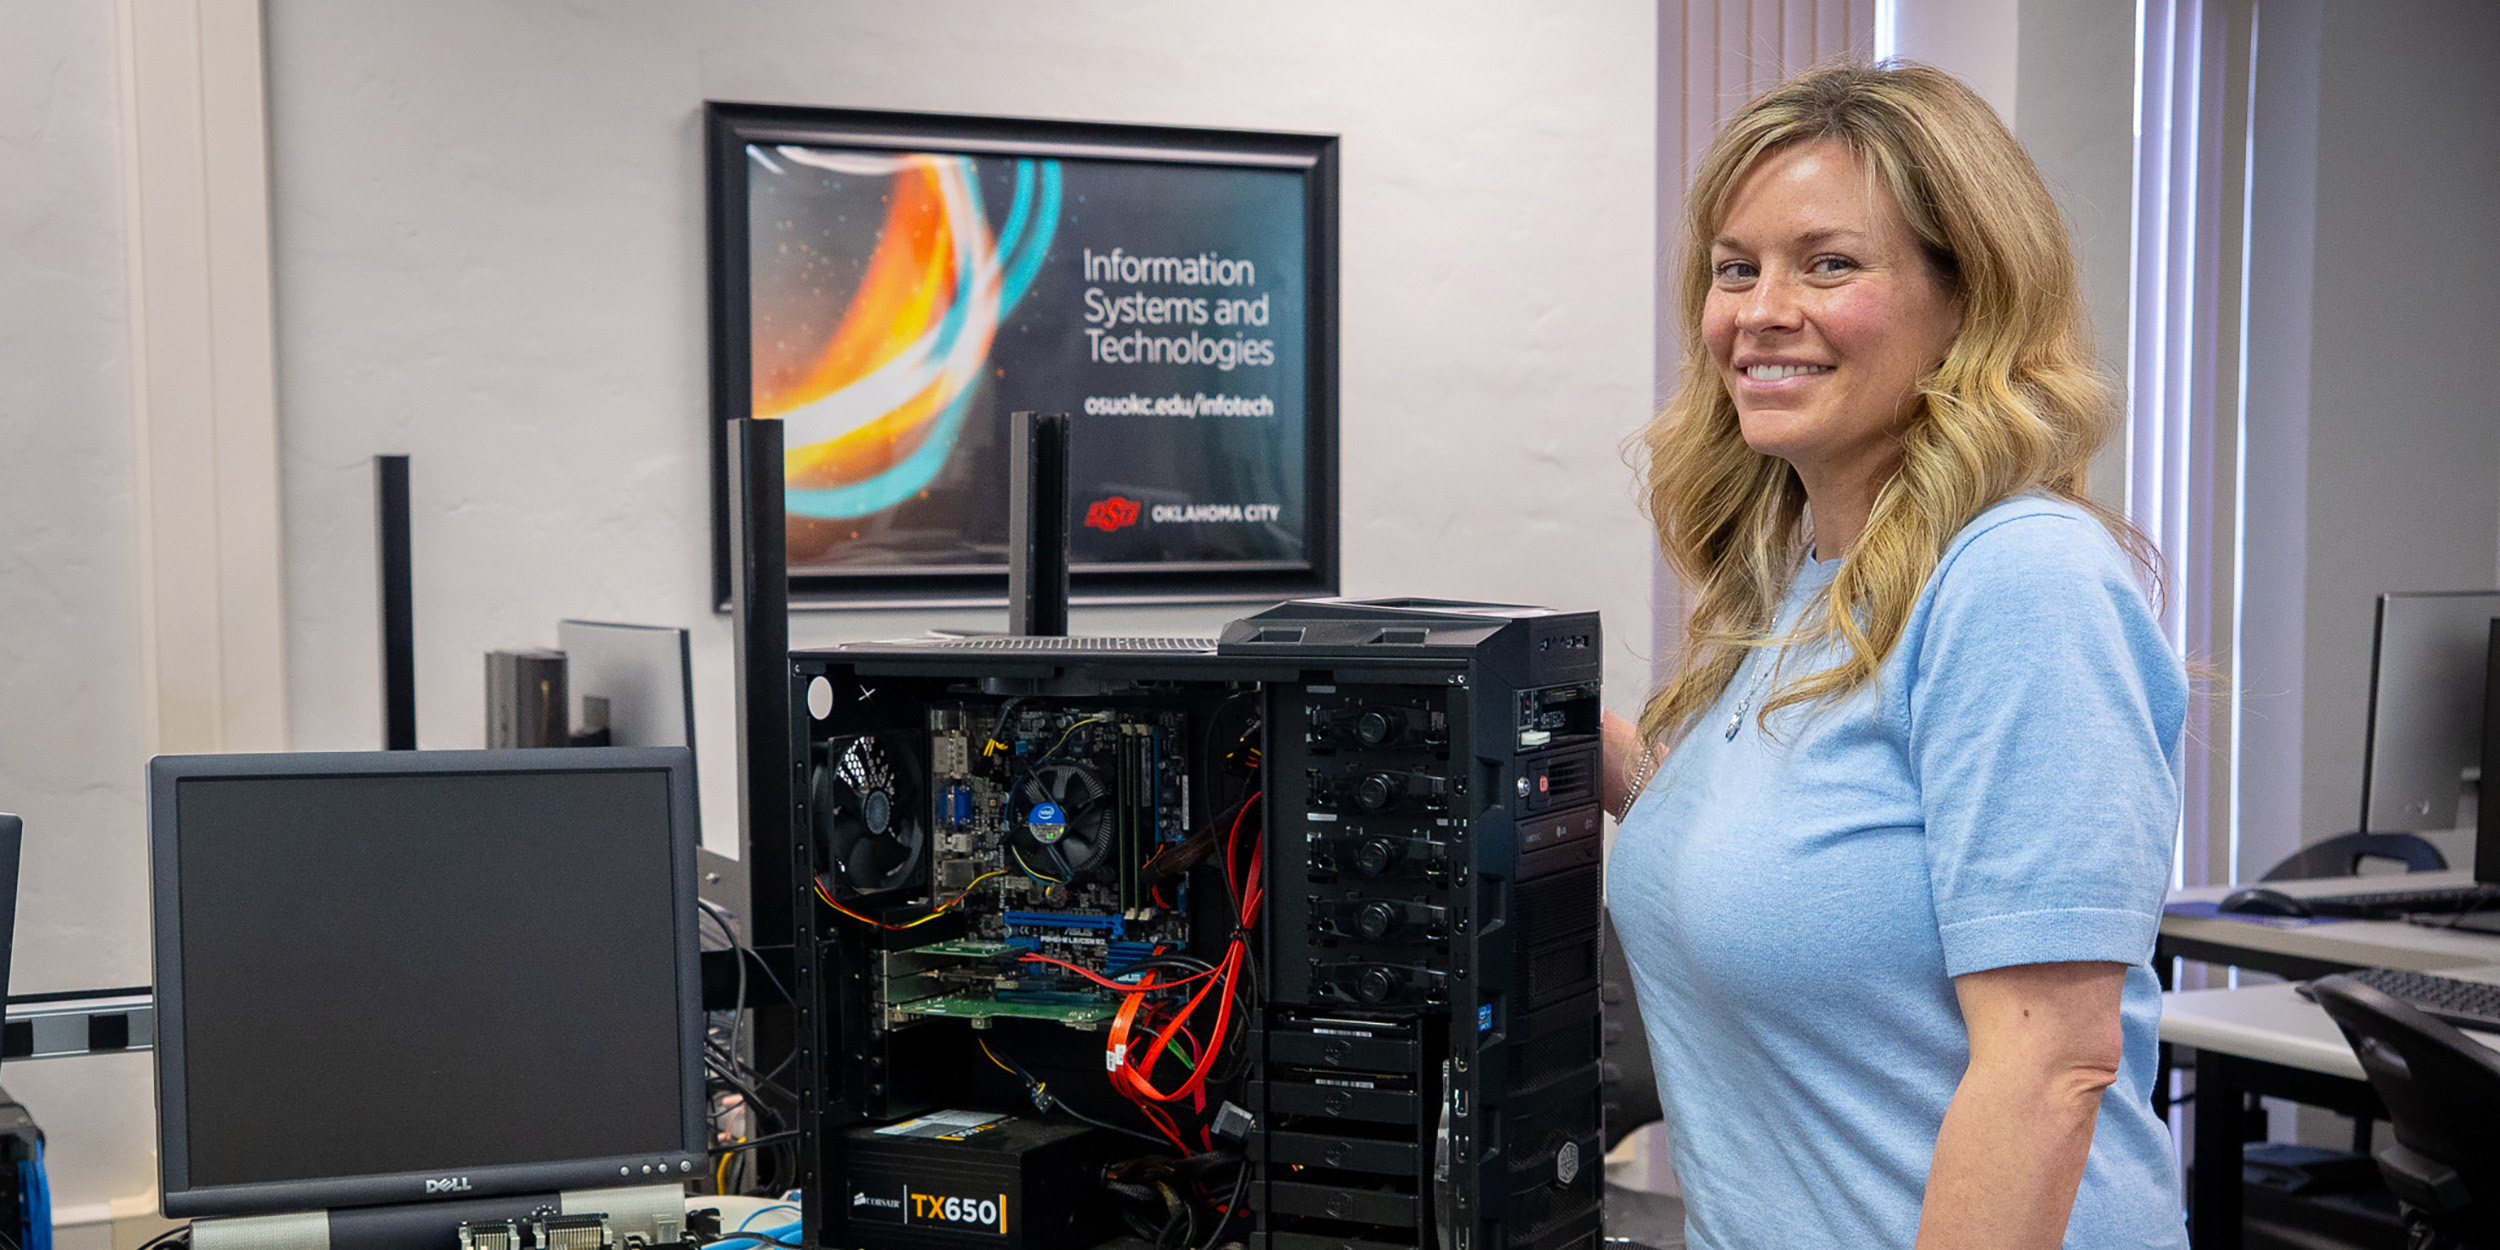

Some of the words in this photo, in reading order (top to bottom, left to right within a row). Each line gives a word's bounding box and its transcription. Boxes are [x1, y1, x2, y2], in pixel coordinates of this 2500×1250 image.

[1083, 247, 1255, 287] Information
[1083, 287, 1209, 329] Systems
[1214, 292, 1270, 327] and
[1083, 327, 1275, 371] Technologies
[1083, 391, 1275, 419] osuokc.edu/infotech
[1152, 504, 1243, 524] OKLAHOMA
[1244, 504, 1281, 523] CITY
[425, 1177, 472, 1194] DELL
[866, 1197, 901, 1209] CORSAIR
[911, 1193, 997, 1226] TX650
